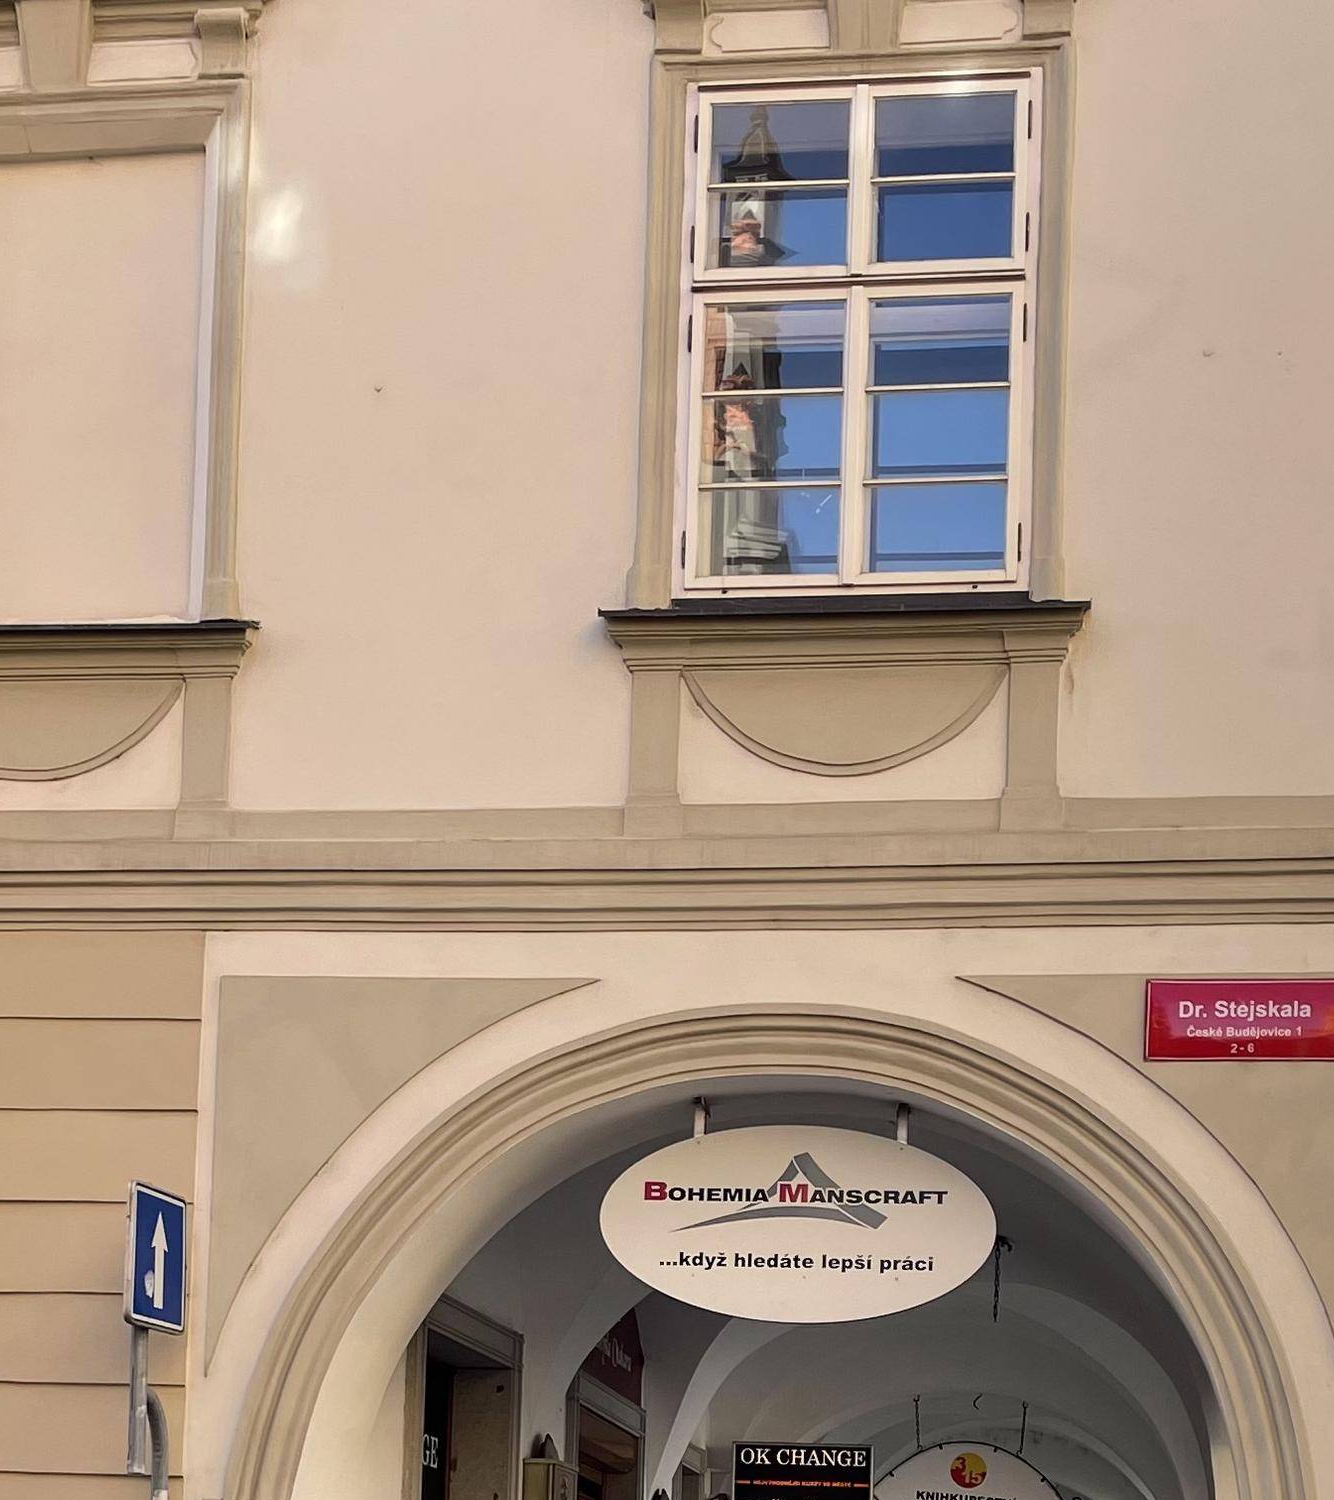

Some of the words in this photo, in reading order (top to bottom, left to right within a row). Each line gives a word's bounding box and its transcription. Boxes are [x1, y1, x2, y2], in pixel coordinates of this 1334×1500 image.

[1178, 1000, 1208, 1018] Dr.
[1214, 1000, 1312, 1022] Stejskala
[1186, 1024, 1223, 1038] České
[1225, 1026, 1293, 1040] Budějovice
[1295, 1026, 1303, 1037] 1
[659, 1252, 728, 1271] ...když
[733, 1253, 814, 1270] hledáte
[821, 1254, 872, 1273] lepší
[878, 1256, 935, 1274] práci
[740, 1447, 772, 1465] OK
[776, 1448, 867, 1468] CHANGE
